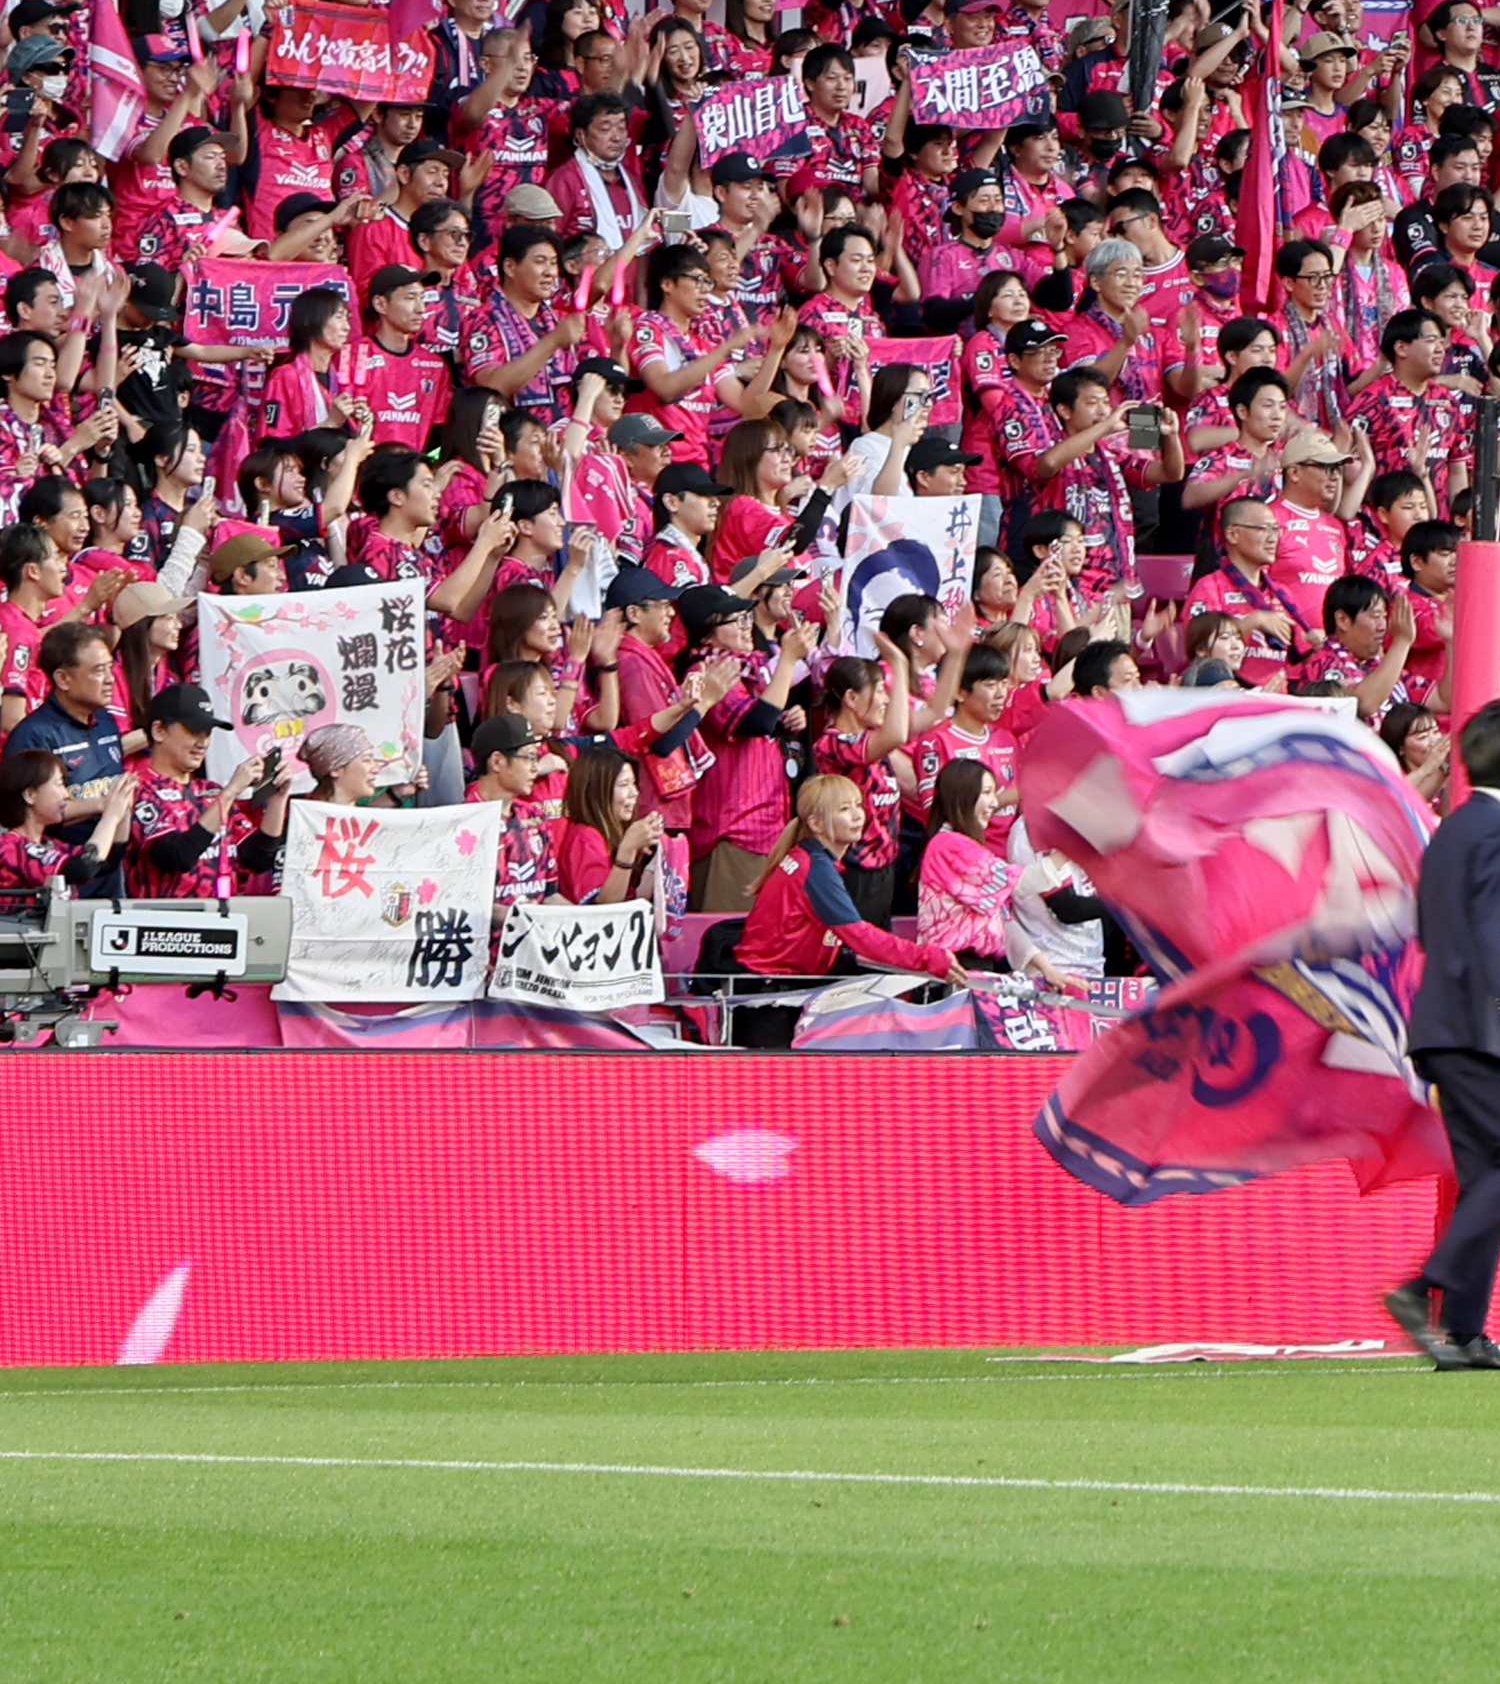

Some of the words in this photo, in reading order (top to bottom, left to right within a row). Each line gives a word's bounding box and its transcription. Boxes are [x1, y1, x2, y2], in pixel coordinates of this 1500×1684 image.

[493, 149, 549, 163] YANMAR
[701, 76, 806, 156] 柴山昌也
[312, 816, 381, 899] 桜
[140, 941, 233, 956] PRODUCTIONS
[405, 907, 474, 990] 勝
